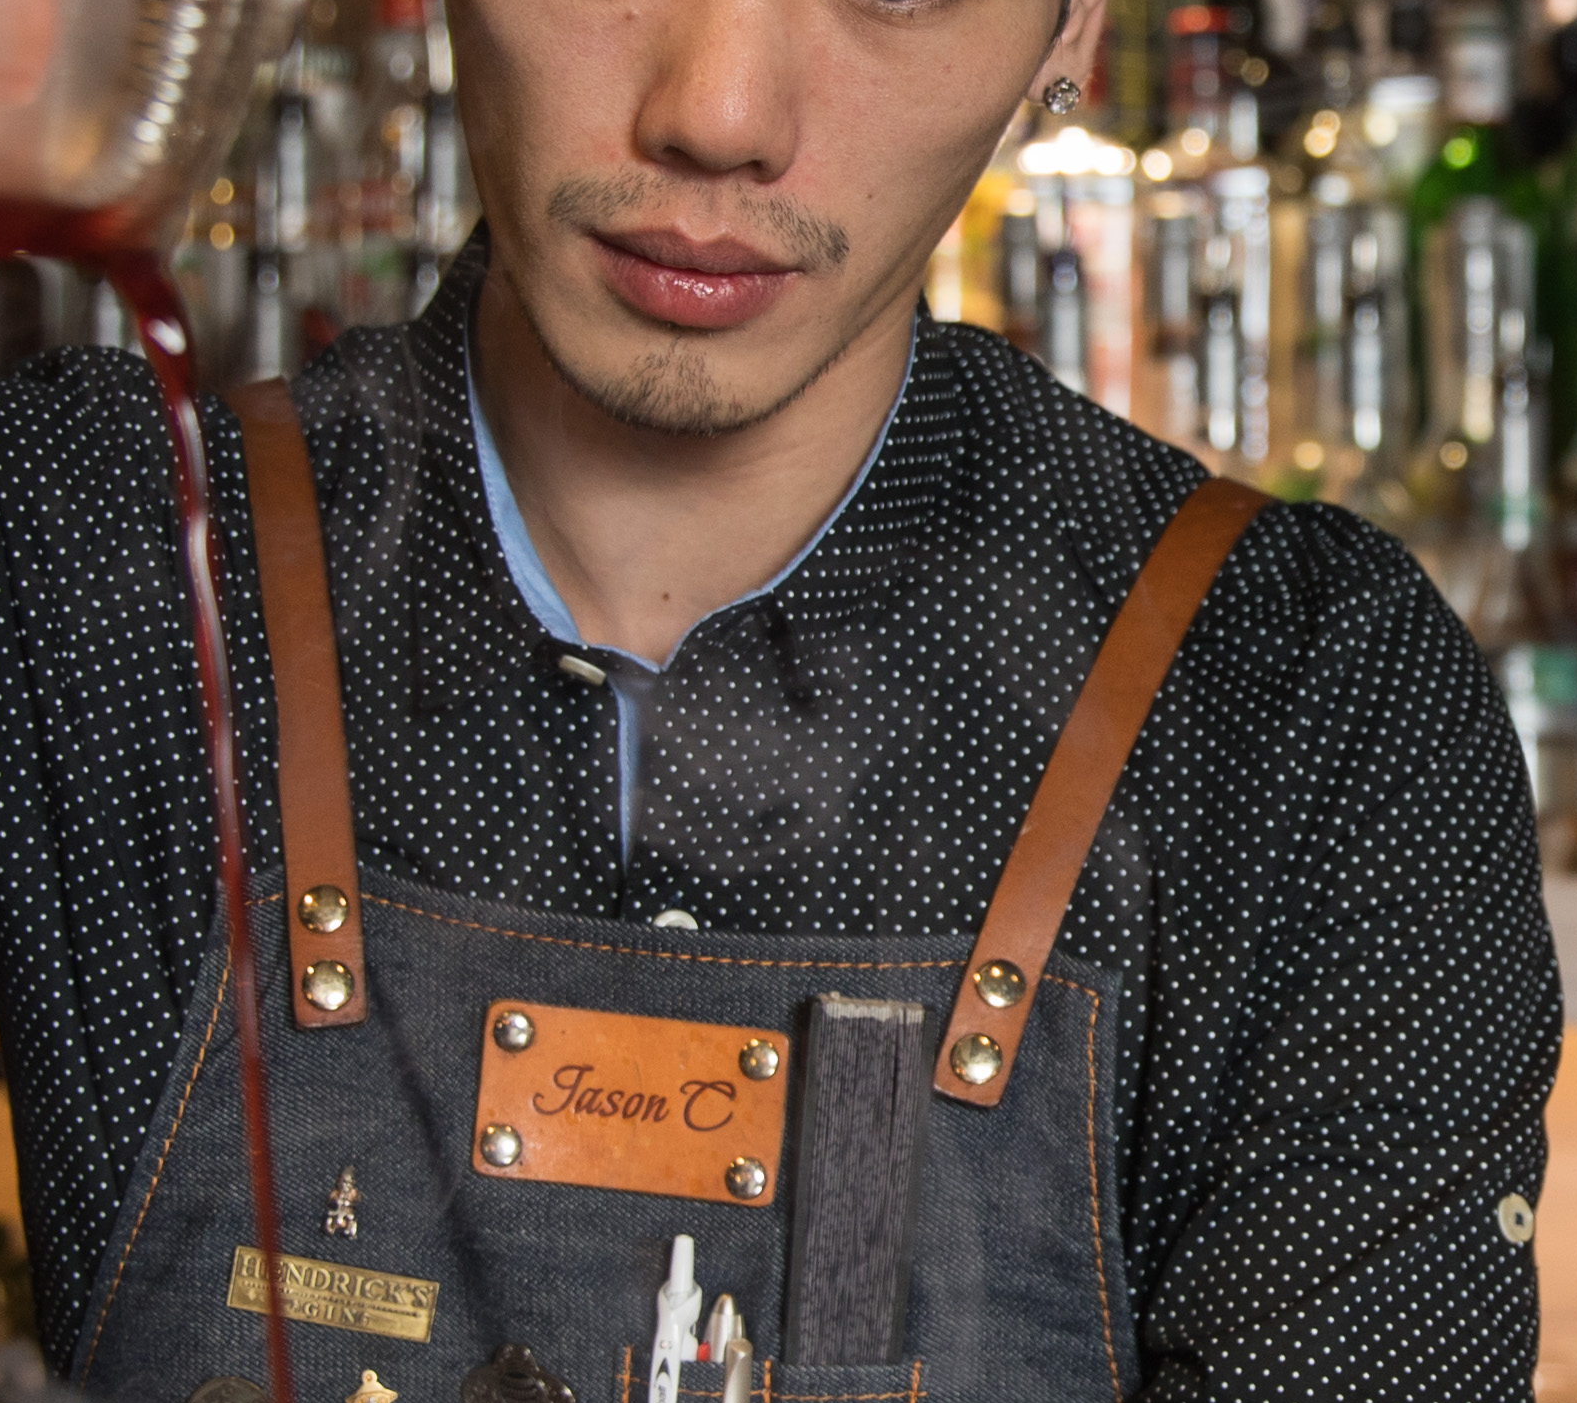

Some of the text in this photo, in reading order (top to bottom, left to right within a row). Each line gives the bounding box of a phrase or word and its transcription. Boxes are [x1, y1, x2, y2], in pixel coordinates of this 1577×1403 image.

[532, 1064, 737, 1133] Jason C
[303, 1300, 358, 1326] GIN
